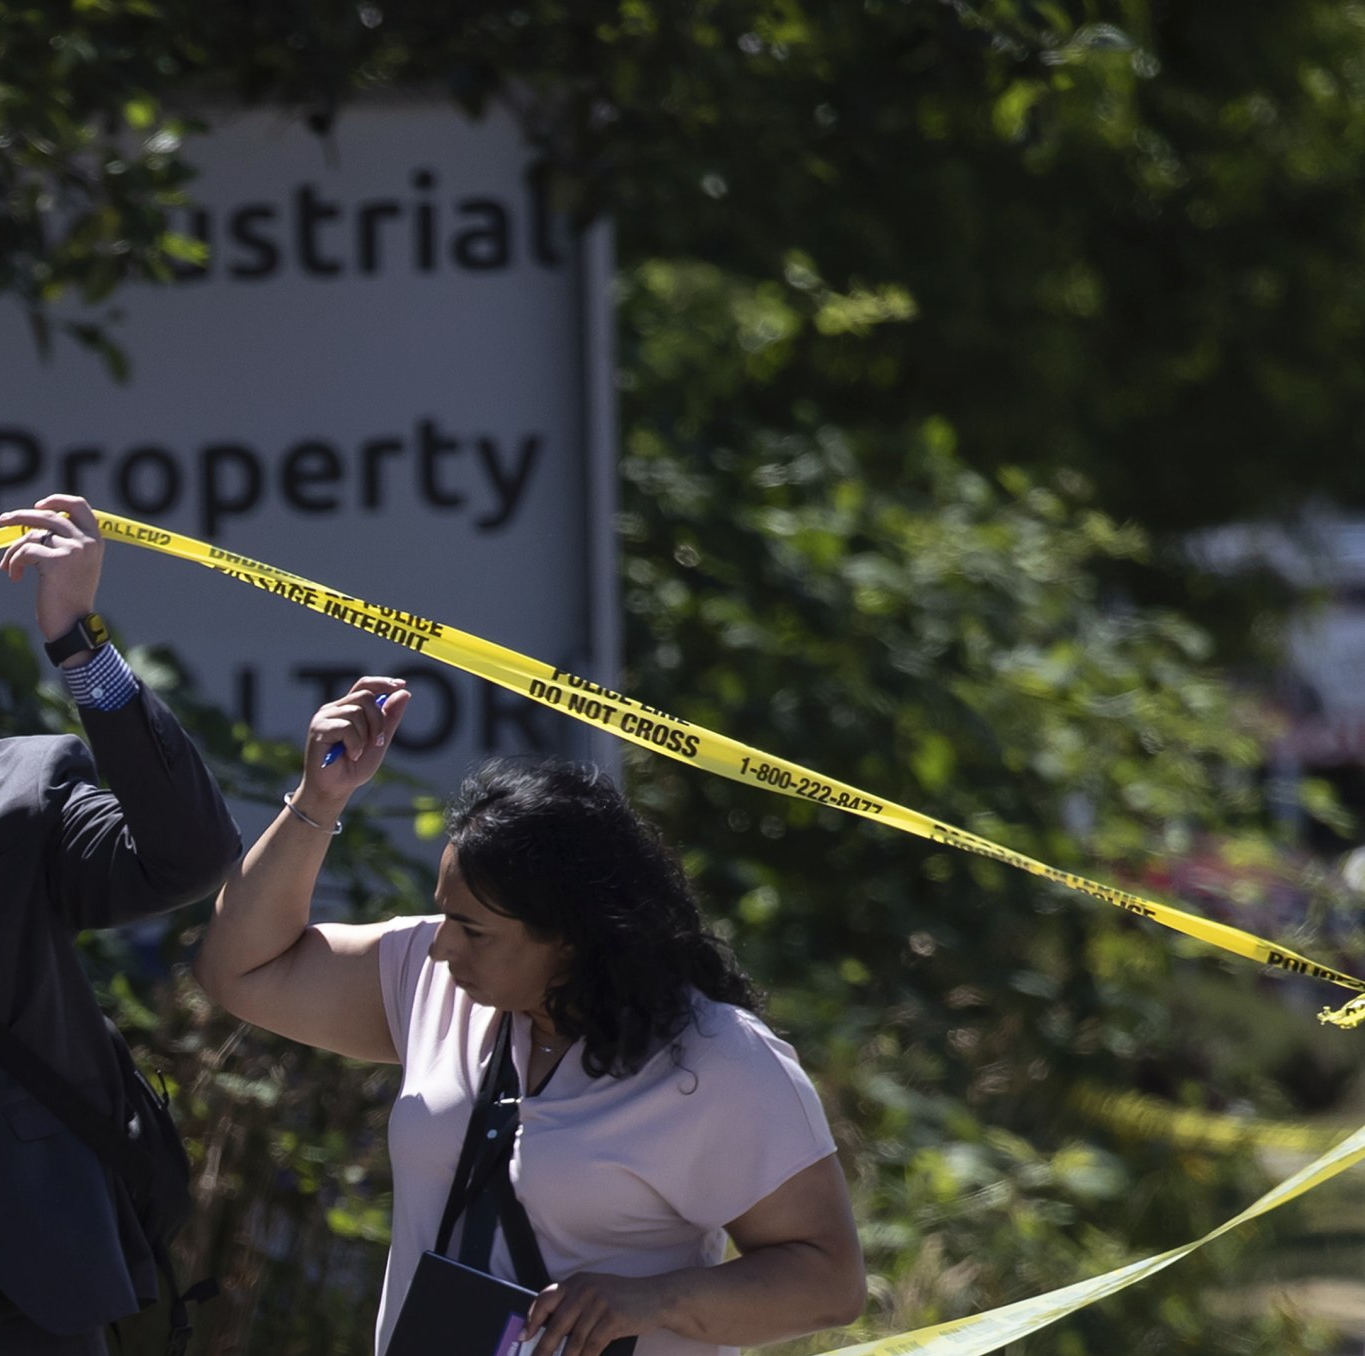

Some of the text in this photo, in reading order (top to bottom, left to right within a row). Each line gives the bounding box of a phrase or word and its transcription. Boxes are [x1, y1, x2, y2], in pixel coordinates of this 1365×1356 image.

[323, 599, 430, 651] INTERDIT
[528, 679, 562, 706] DO
[567, 692, 618, 726] NOT
[620, 712, 701, 760] CROSS
[738, 756, 885, 815] 1-800-222-8477
